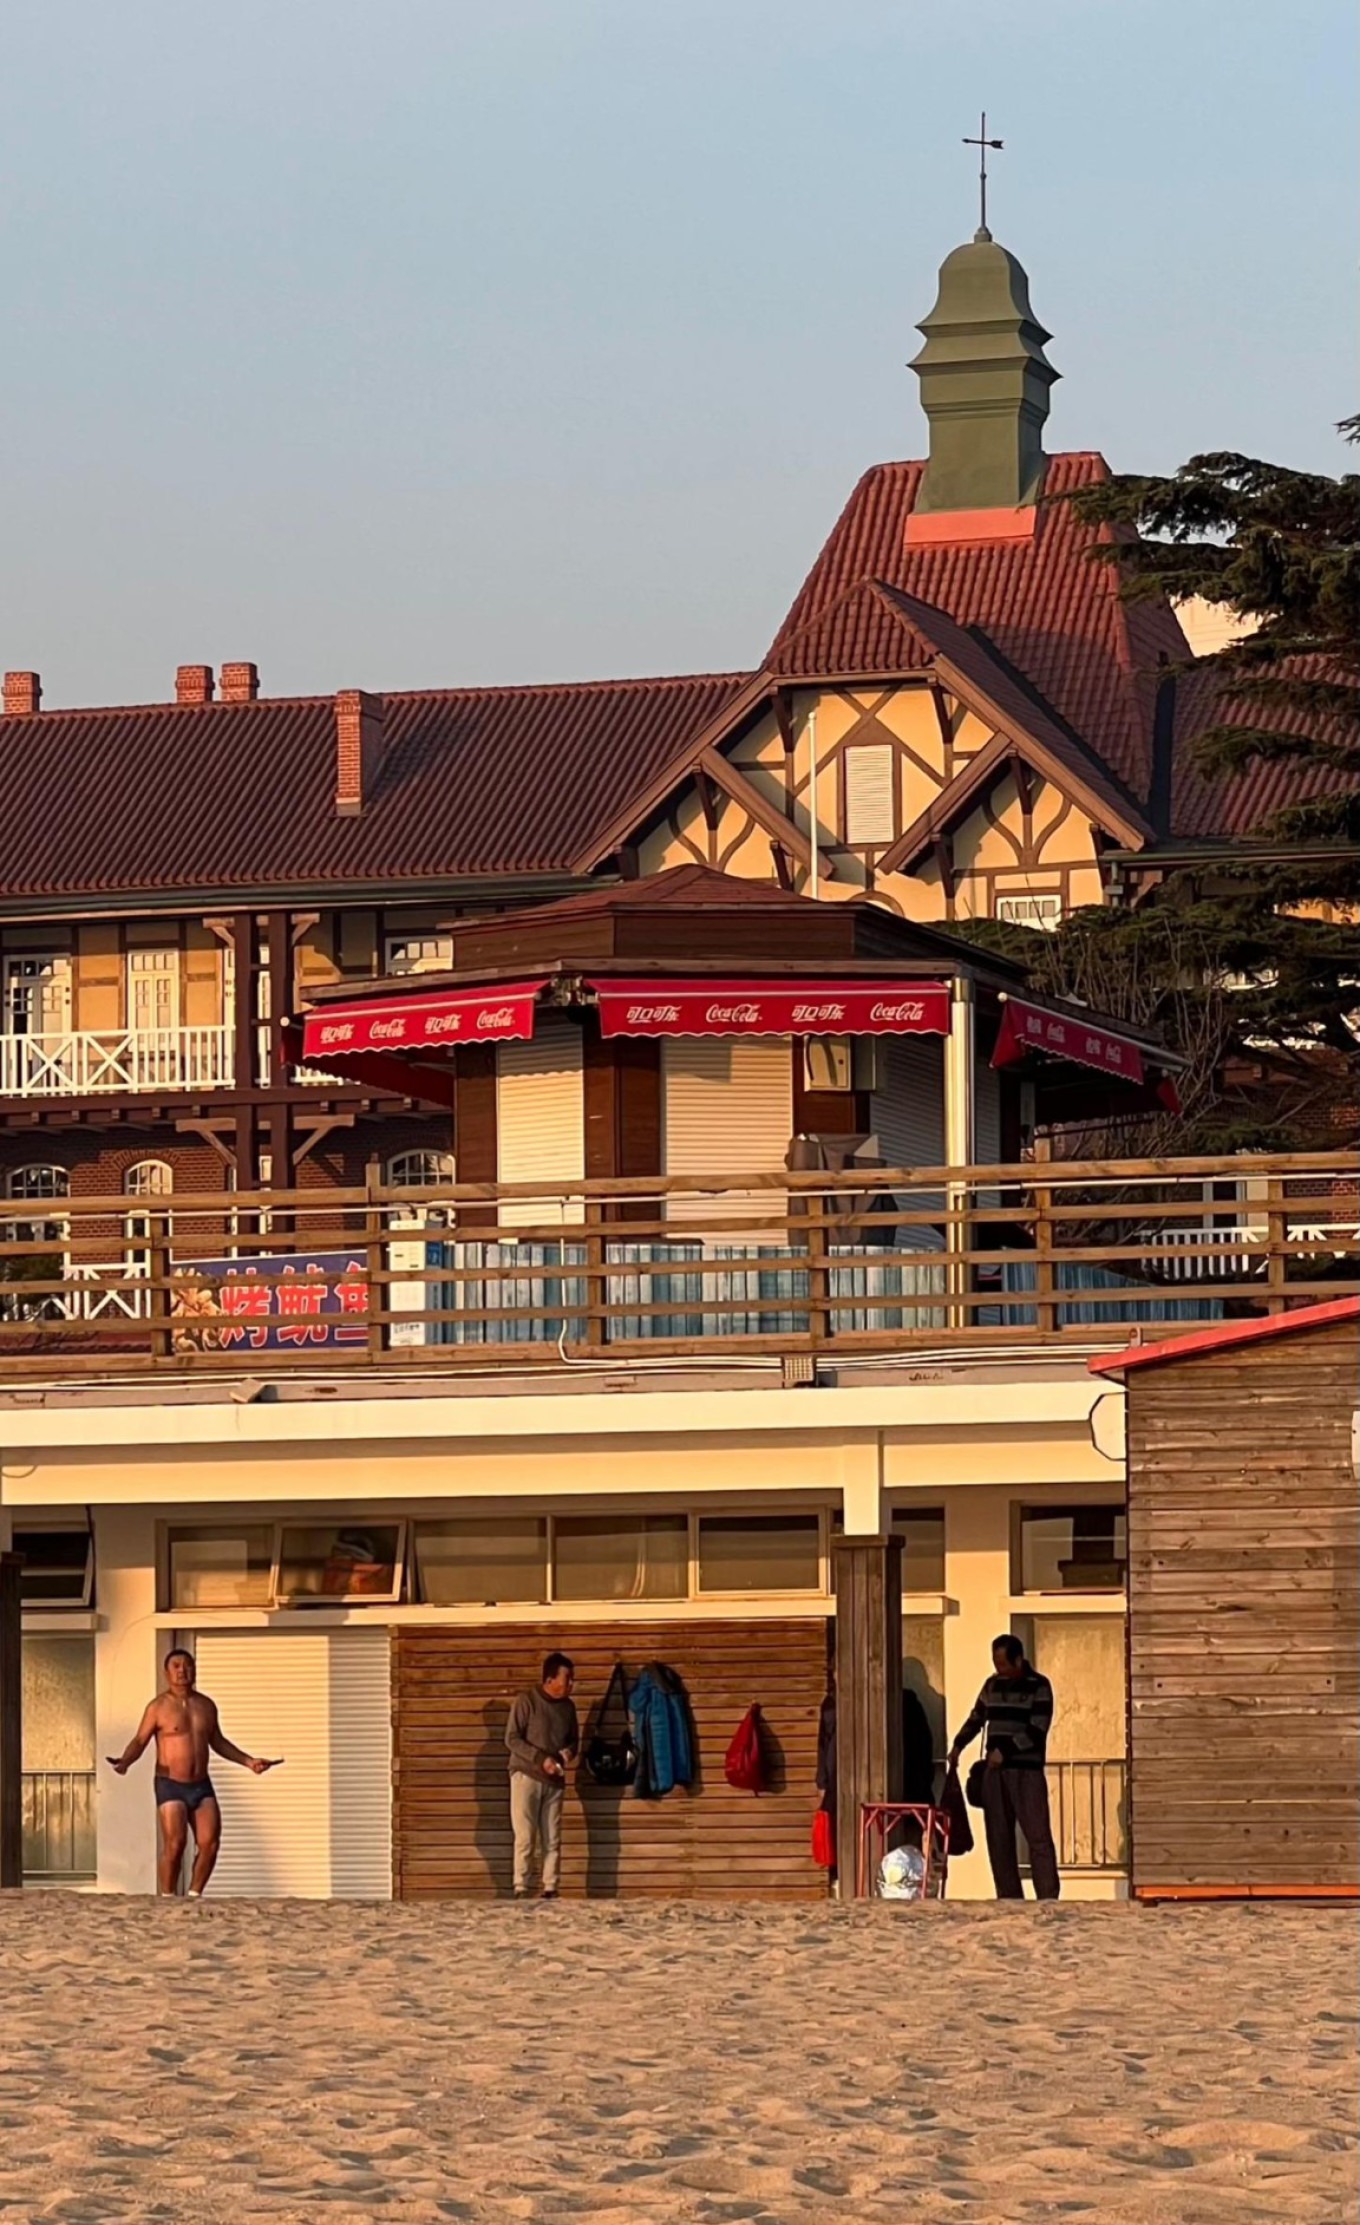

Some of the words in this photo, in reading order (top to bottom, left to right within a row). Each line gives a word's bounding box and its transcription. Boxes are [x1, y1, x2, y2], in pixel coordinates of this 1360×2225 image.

[626, 1004, 682, 1024] 可口可乐
[791, 1003, 847, 1022] 可口可乐
